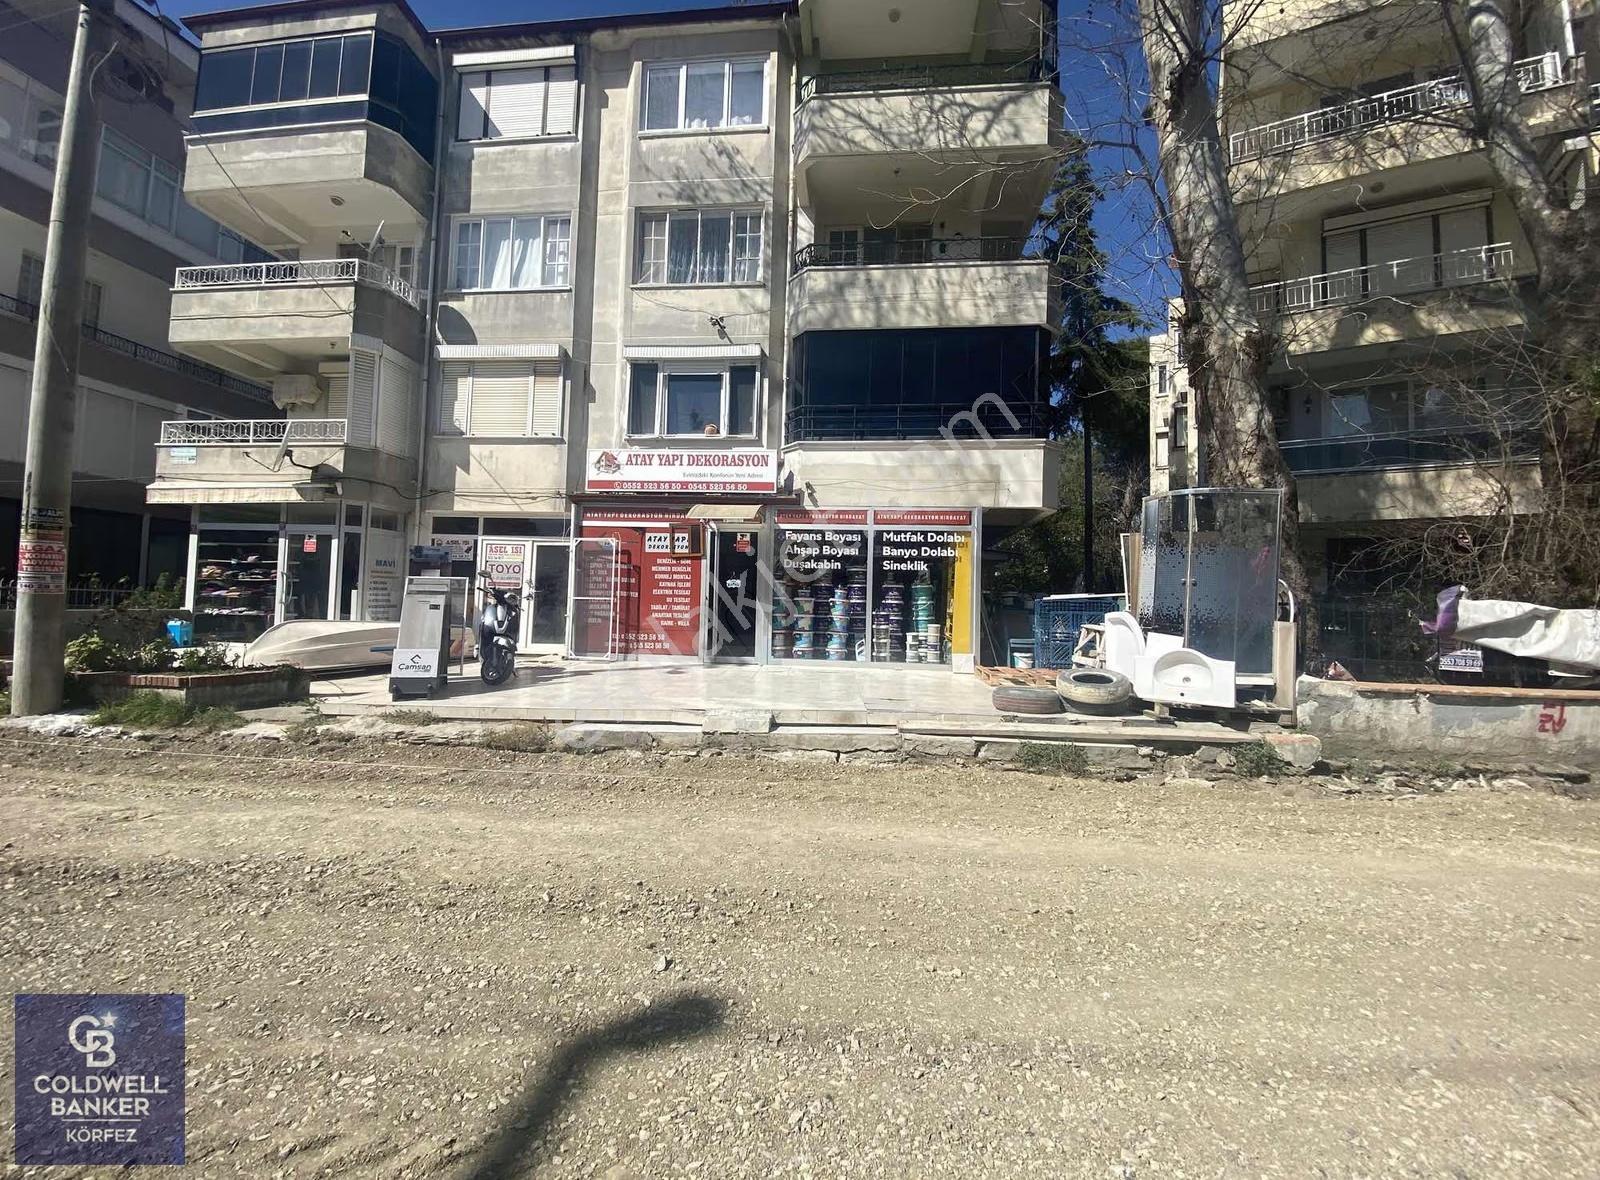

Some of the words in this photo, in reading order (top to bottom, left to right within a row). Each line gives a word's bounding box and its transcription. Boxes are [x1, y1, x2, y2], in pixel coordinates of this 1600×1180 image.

[625, 453, 653, 466] ATAY
[656, 454, 684, 467] YAPI
[687, 454, 770, 468] DEKORASYON
[622, 482, 642, 490] 0552
[643, 482, 658, 490] 523
[659, 482, 670, 490] 56
[671, 482, 682, 490] 50
[688, 482, 707, 491] 0545
[709, 483, 724, 491] 523
[737, 483, 748, 491] 50
[647, 535, 668, 543] ATAY
[785, 531, 822, 542] Fayans
[824, 531, 861, 542] Boyası
[882, 531, 925, 542] Mutfak
[927, 531, 965, 543] Dolabı
[488, 545, 508, 554] ASEL
[784, 545, 820, 556] Ahşap
[822, 545, 859, 556] Boyası
[882, 546, 919, 558] Banyo
[921, 546, 959, 557] Dolabı
[488, 564, 521, 574] TOYO
[783, 559, 842, 571] Duşakabin
[882, 561, 928, 571] Sineklik
[398, 663, 432, 672] Çamsan
